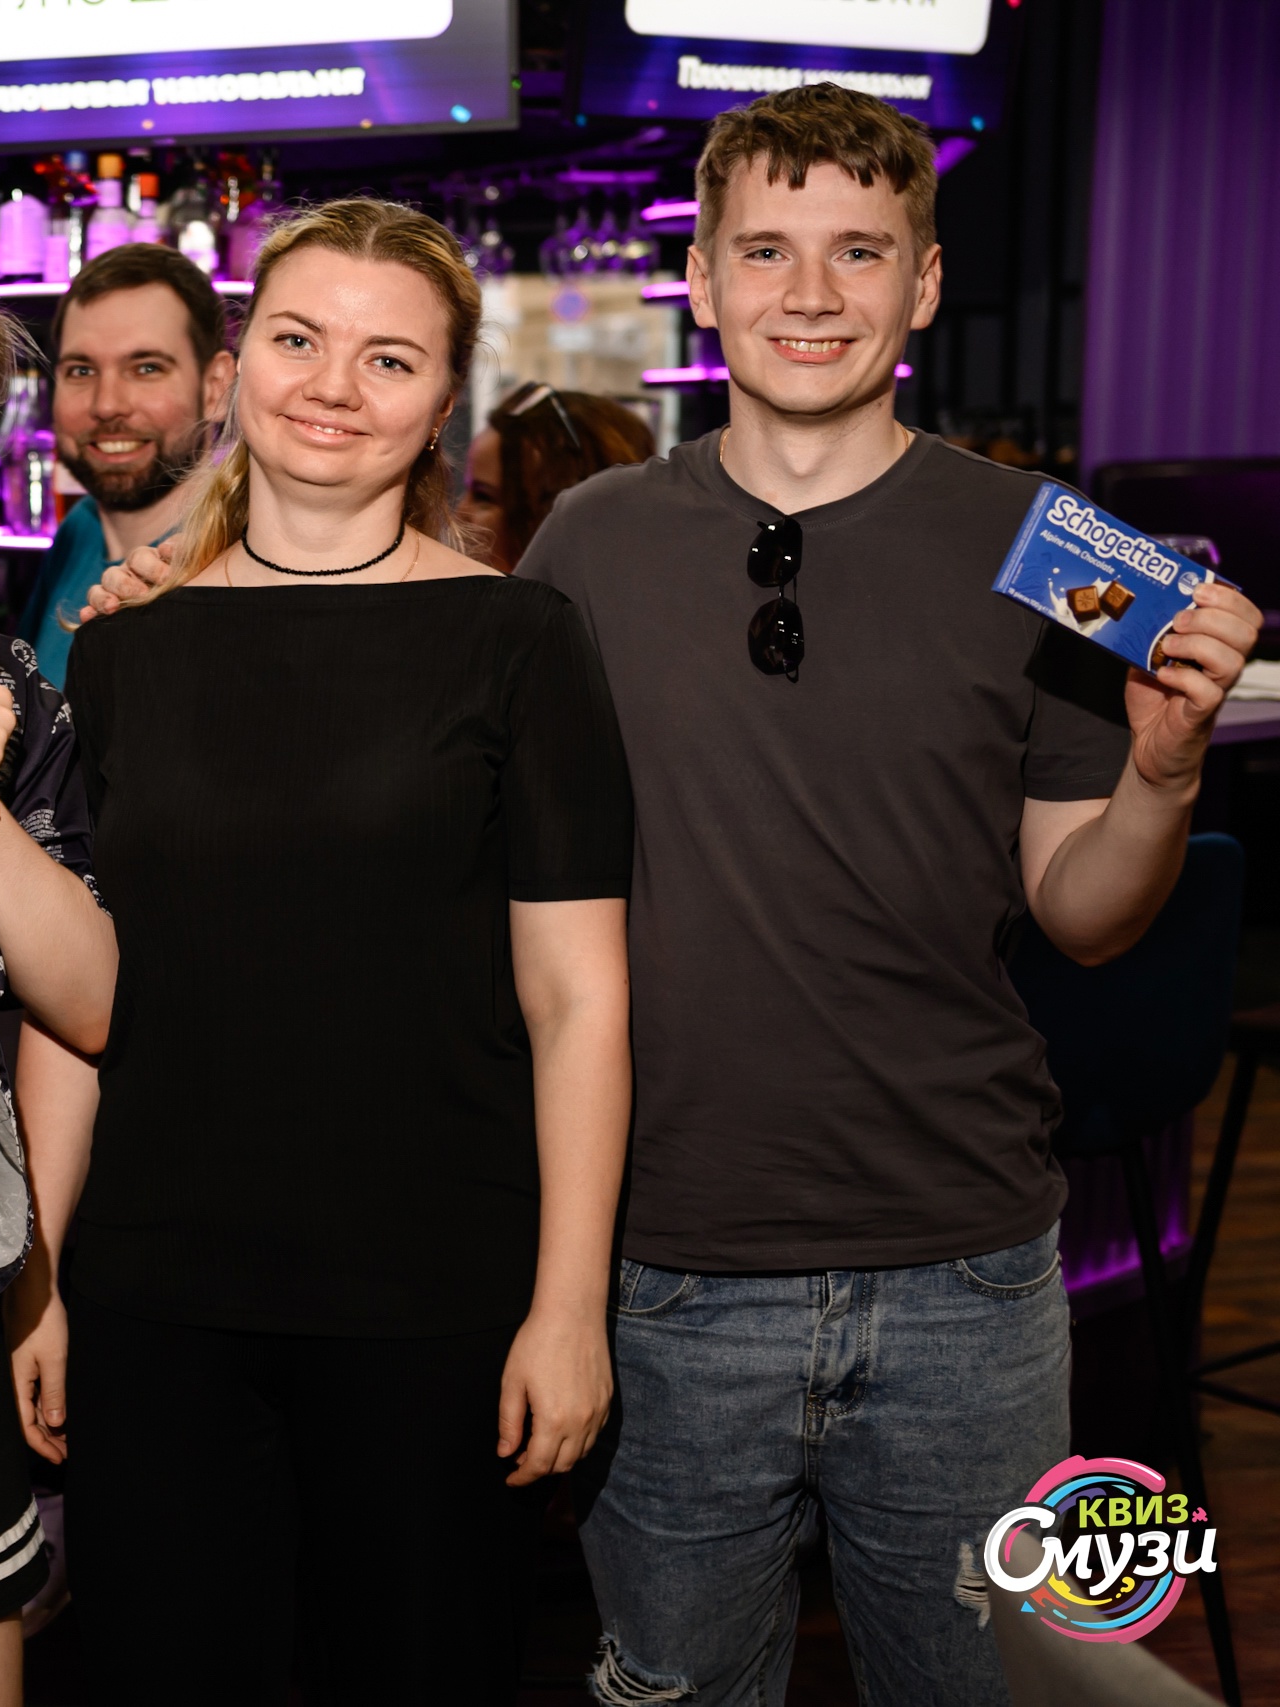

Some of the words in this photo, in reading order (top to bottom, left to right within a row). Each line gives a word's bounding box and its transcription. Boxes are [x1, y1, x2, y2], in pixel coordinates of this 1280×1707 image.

[1040, 529, 1065, 547] Alpine
[1064, 541, 1081, 556] Milk
[1080, 550, 1115, 575] Chocolate
[1047, 495, 1179, 586] Schogetten
